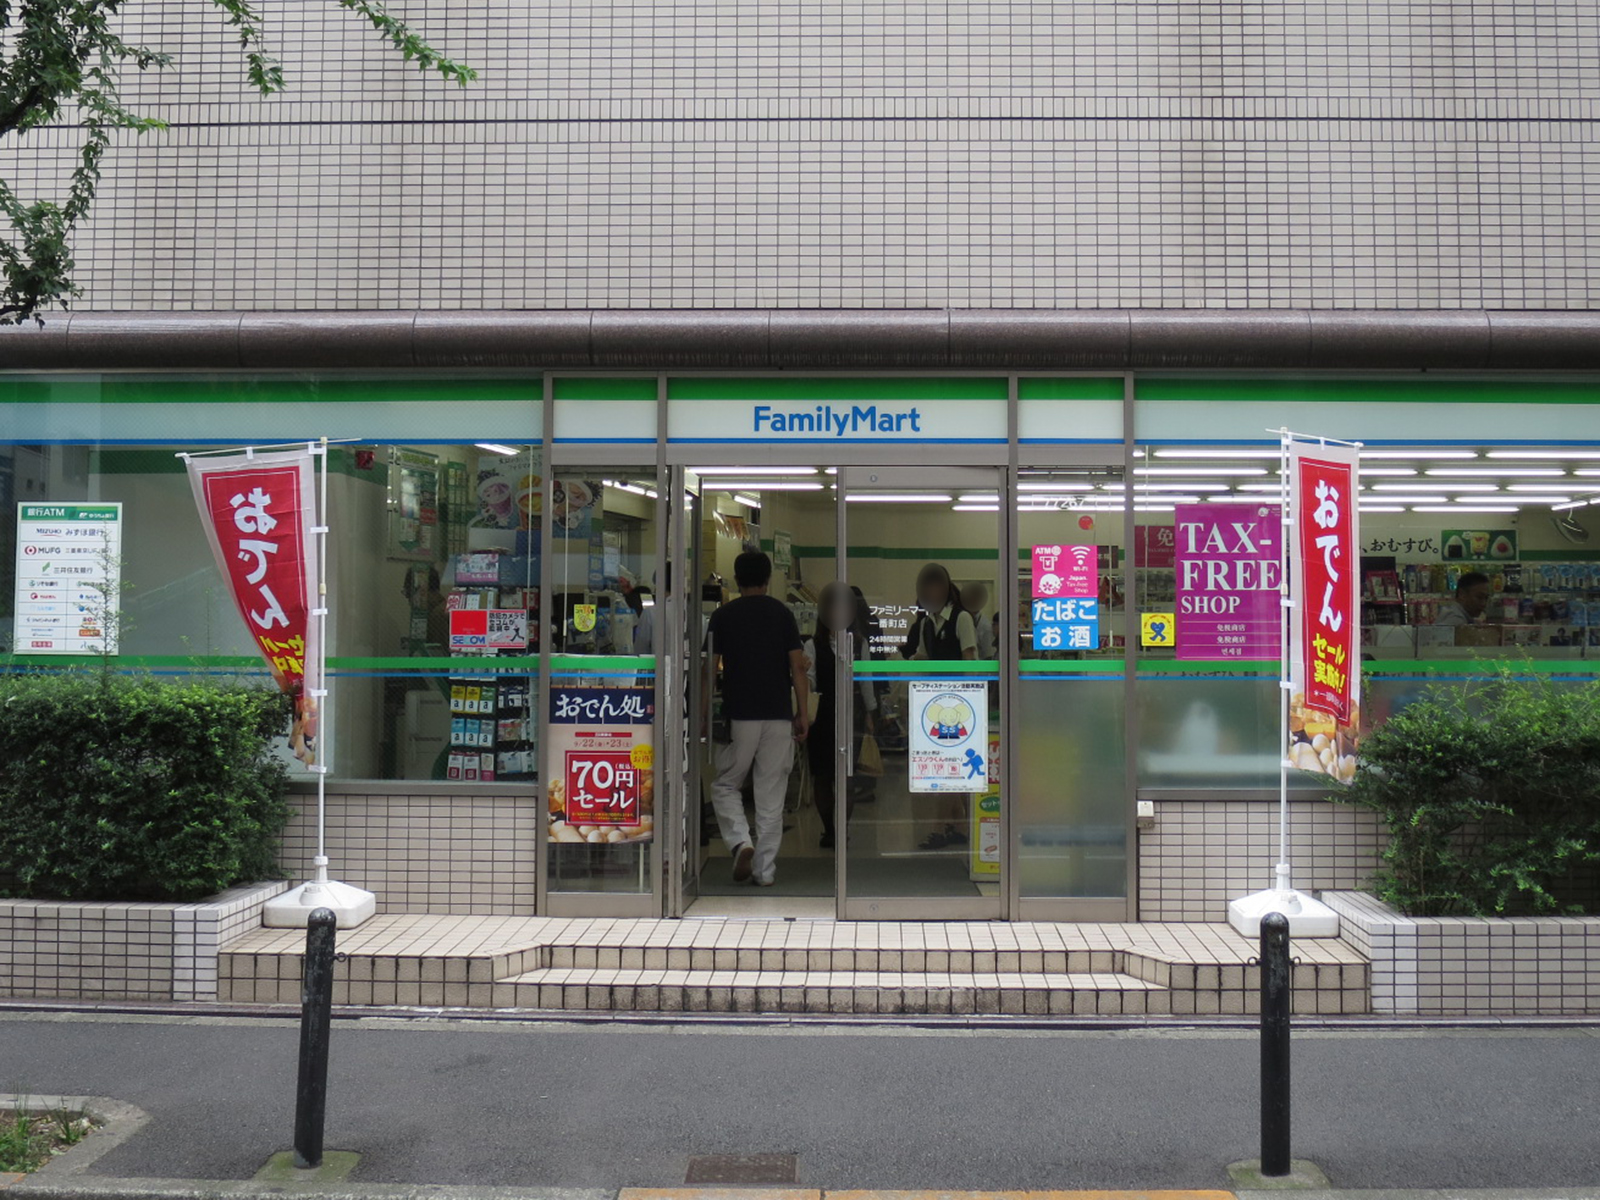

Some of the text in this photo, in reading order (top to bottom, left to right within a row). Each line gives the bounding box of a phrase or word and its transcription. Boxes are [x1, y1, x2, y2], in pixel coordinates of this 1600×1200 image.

[754, 406, 920, 436] FamilyMart
[27, 508, 65, 516] 銀行ATM
[1180, 522, 1272, 553] TAX-
[1312, 480, 1343, 633] おでん
[1180, 560, 1281, 591] FREE
[869, 606, 929, 616] ファミリーマー
[1034, 600, 1097, 621] たばこ
[1181, 596, 1240, 614] SHOP
[869, 619, 908, 628] 一番町店
[453, 636, 486, 644] SECOM
[1041, 626, 1091, 647] お酒
[1312, 633, 1346, 665] セール
[555, 694, 646, 719] おでん処
[571, 760, 634, 789] 70円
[572, 790, 634, 809] セール
